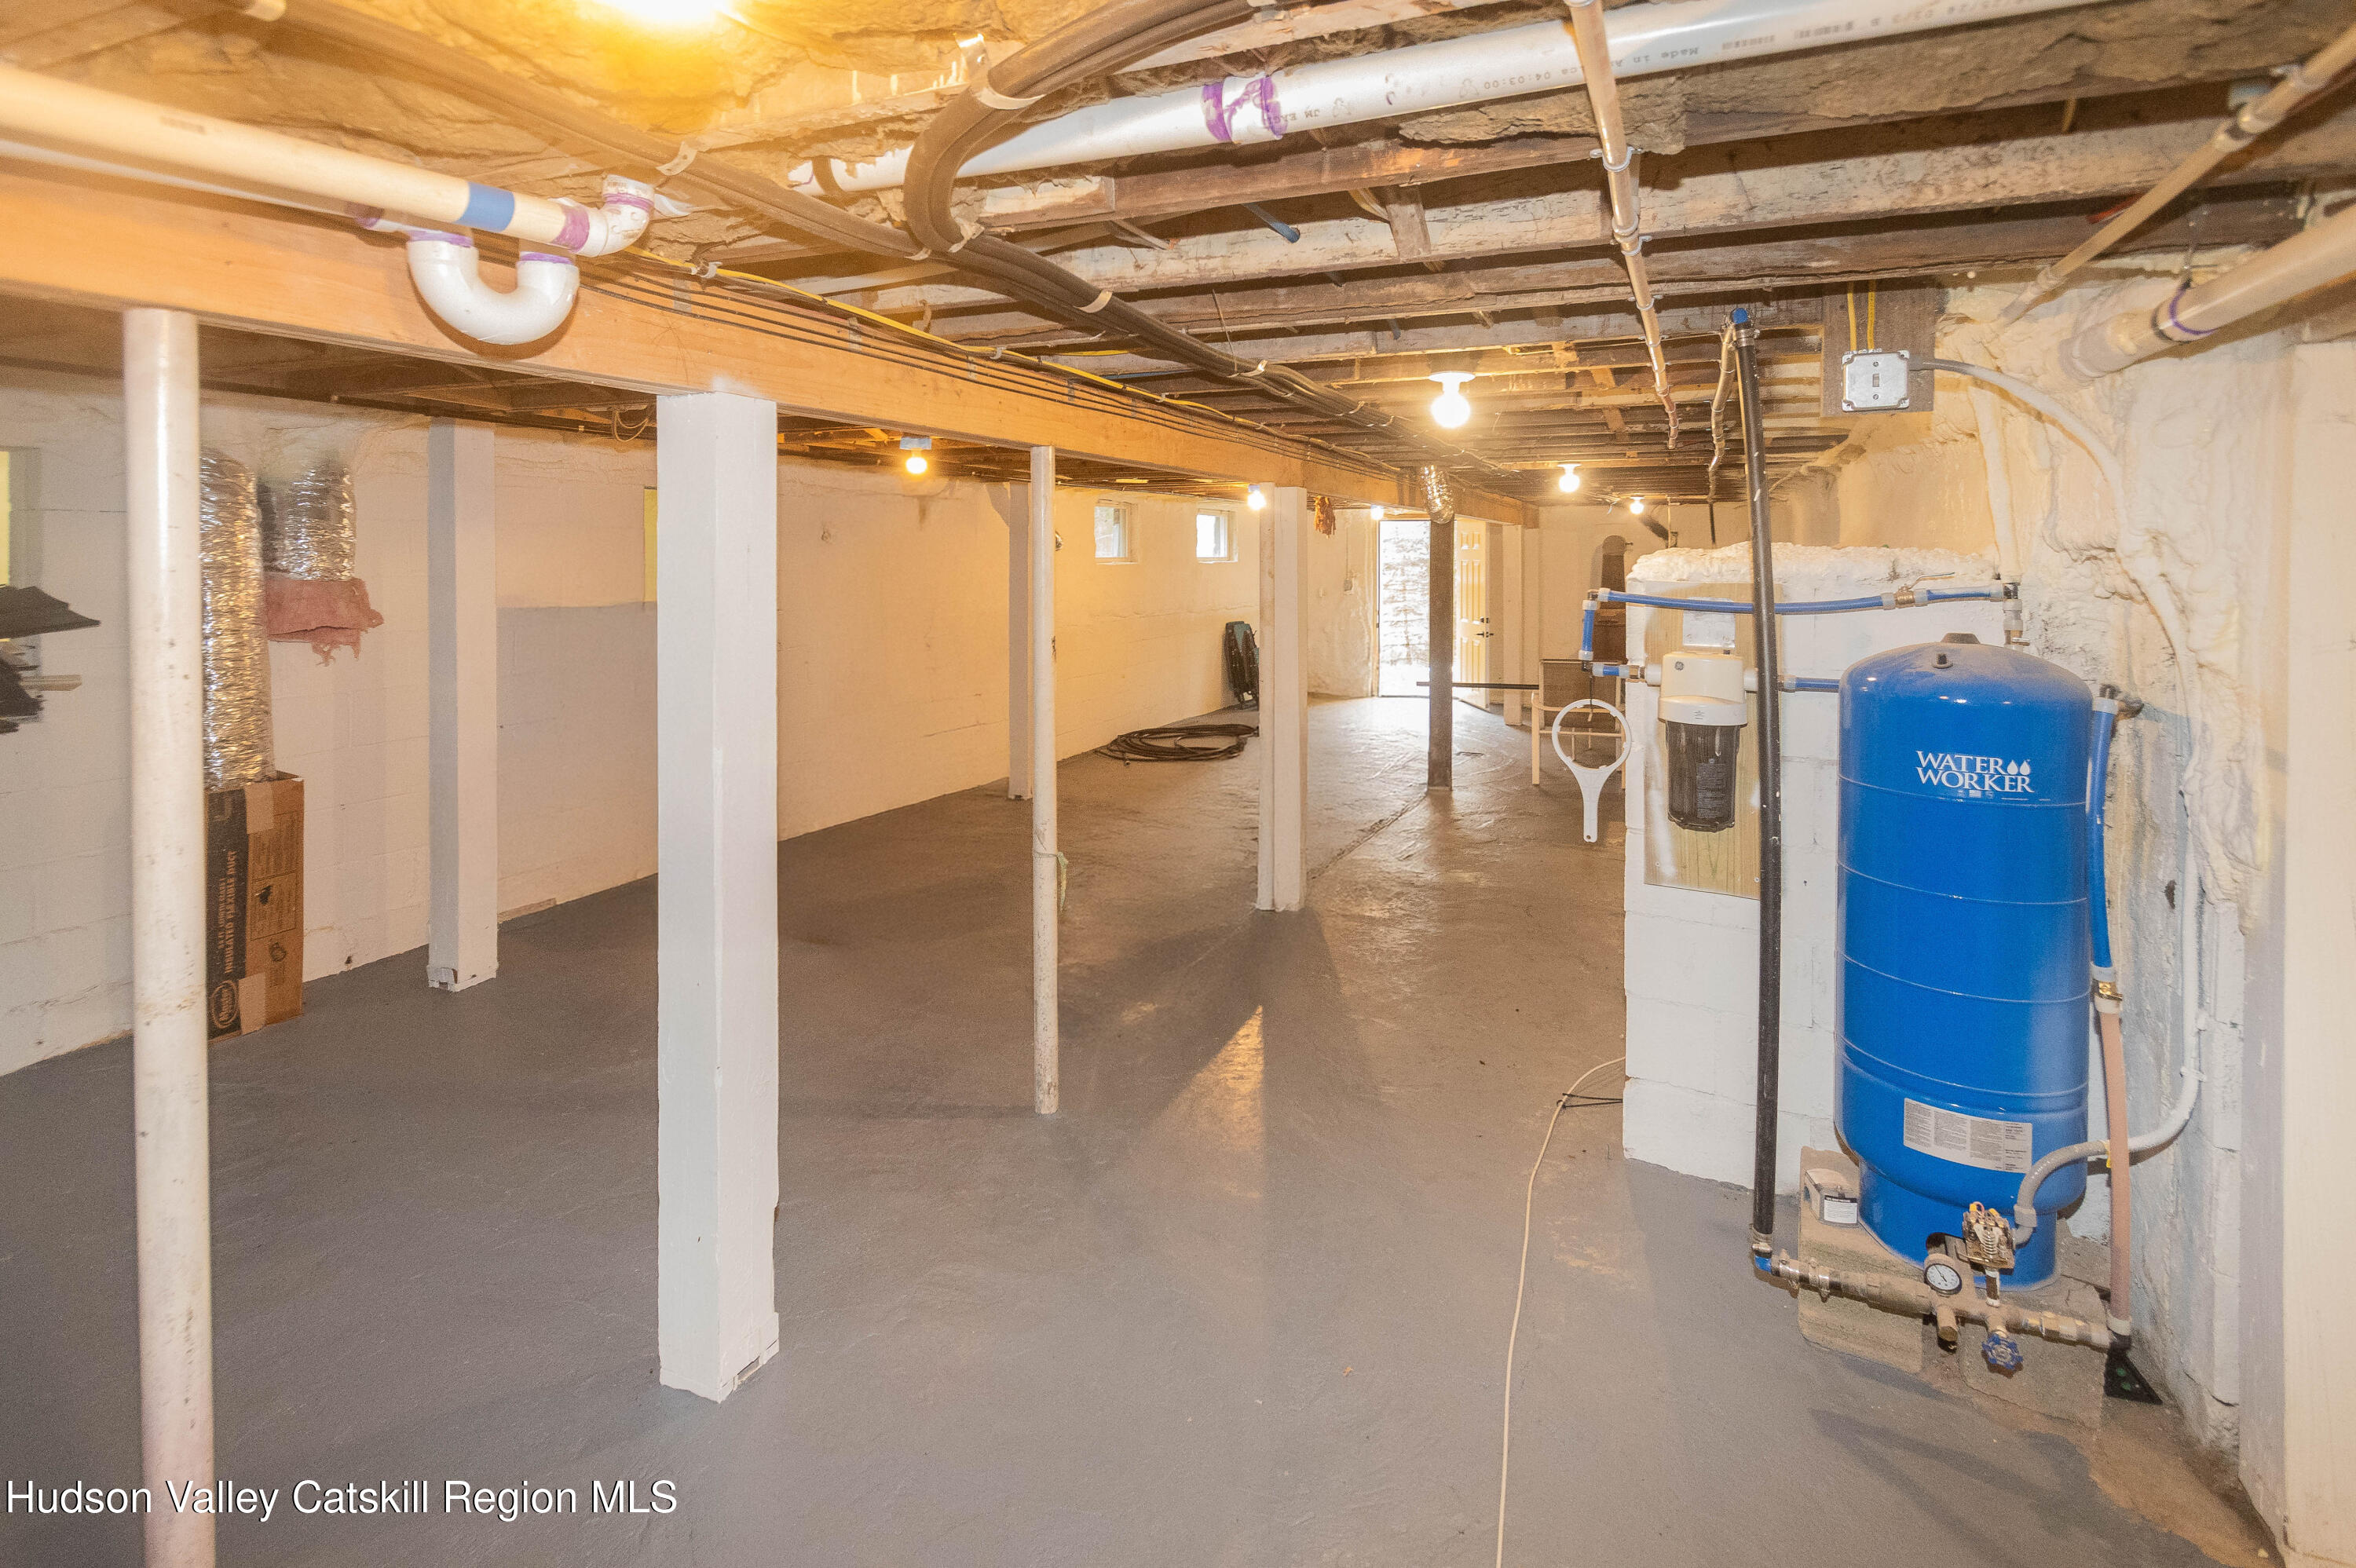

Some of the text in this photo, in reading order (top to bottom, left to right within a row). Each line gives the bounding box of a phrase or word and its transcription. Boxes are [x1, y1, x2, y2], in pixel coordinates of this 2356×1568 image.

[1483, 47, 1699, 89] Made in 04:03:00
[1303, 108, 1320, 118] JM
[1916, 750, 2007, 775] WATER
[1916, 767, 2035, 792] WORKER
[226, 850, 237, 875] DUCT
[225, 875, 236, 919] FLEXIBLE
